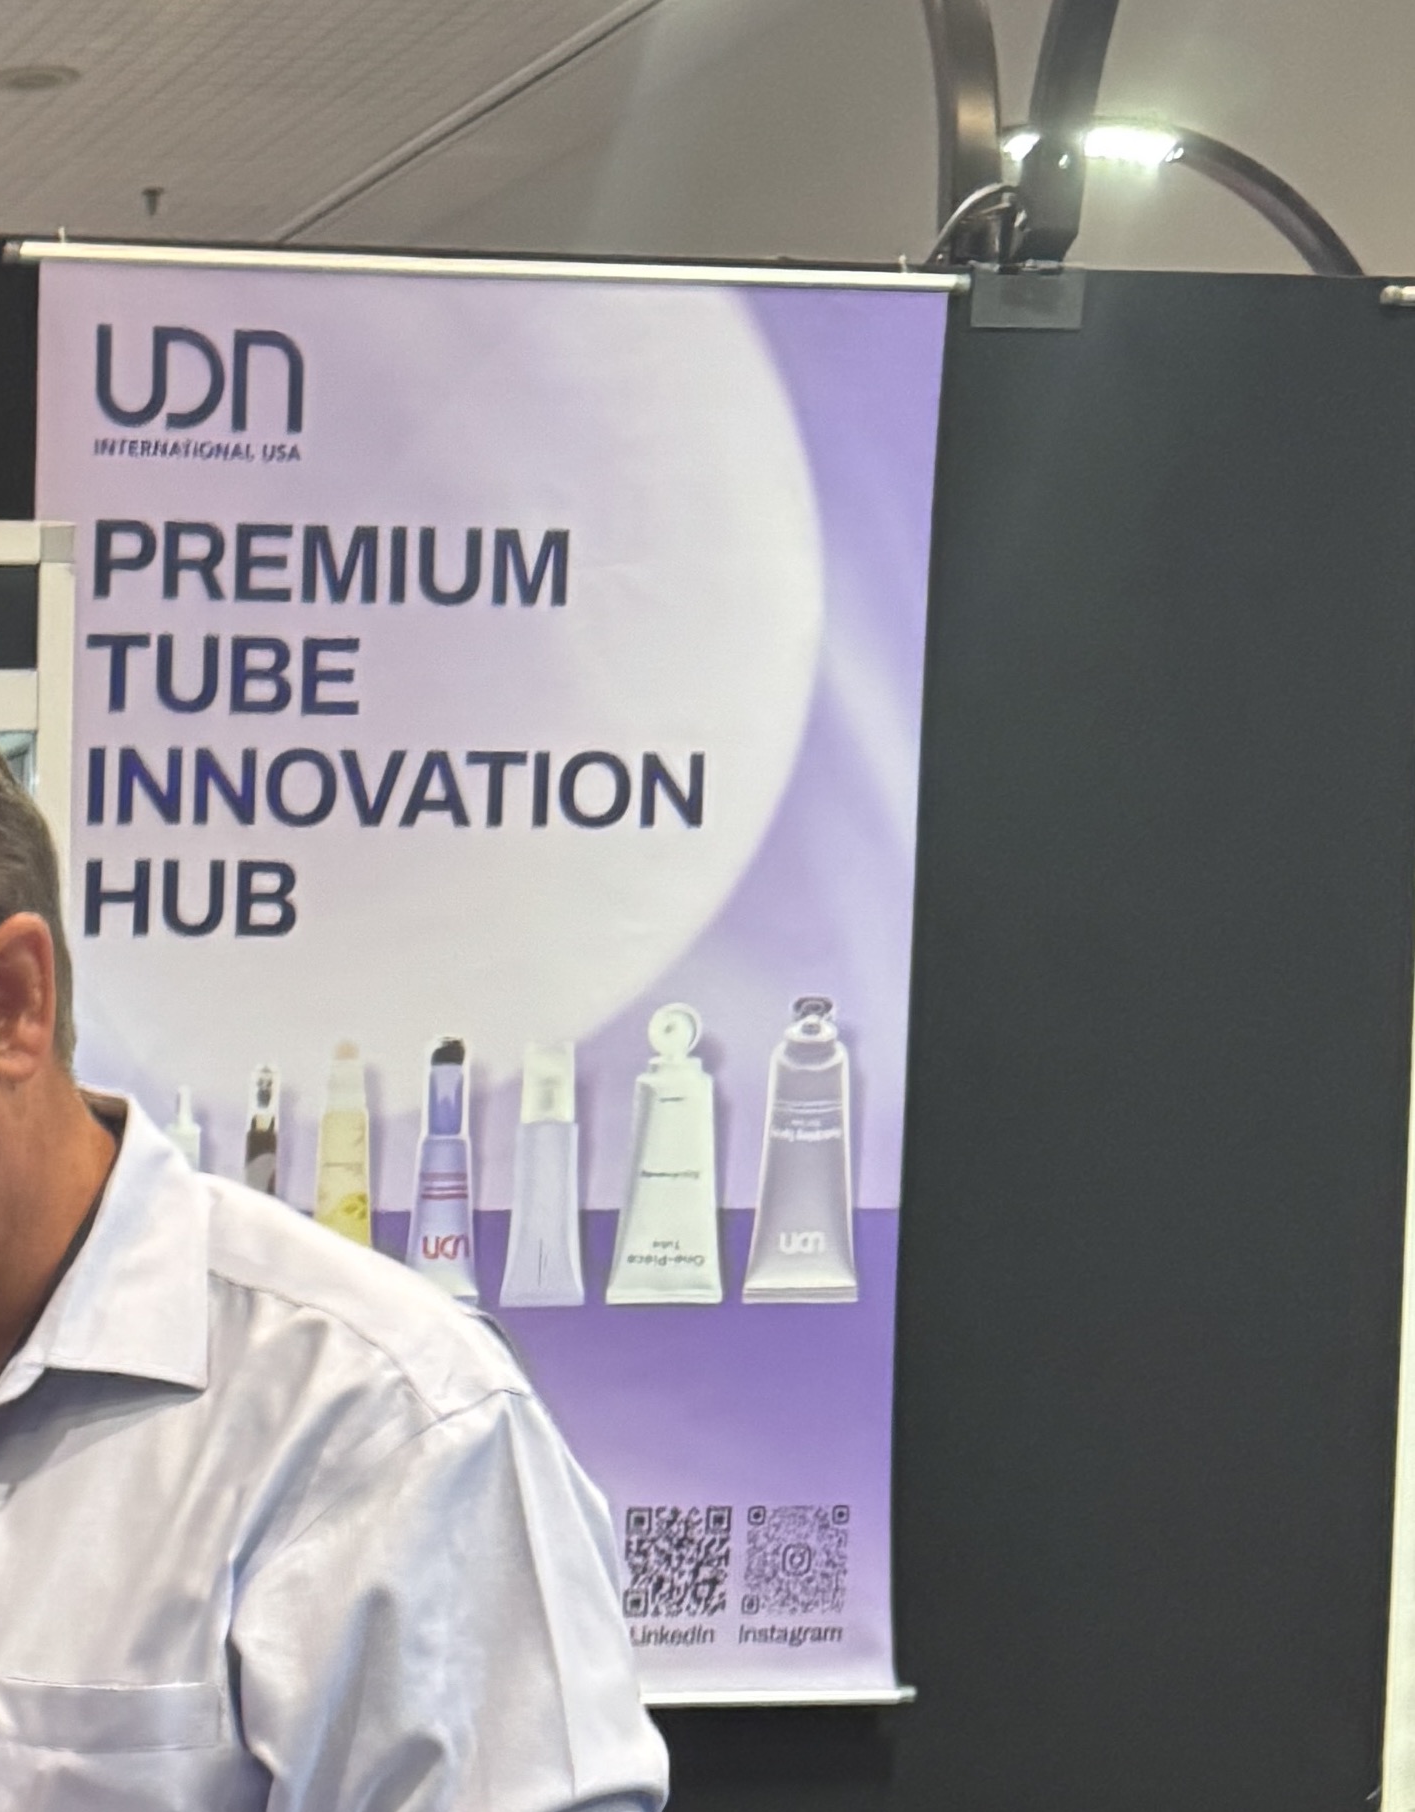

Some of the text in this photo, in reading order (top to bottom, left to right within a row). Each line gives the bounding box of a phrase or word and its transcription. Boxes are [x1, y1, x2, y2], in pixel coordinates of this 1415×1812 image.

[93, 438, 301, 463] INTERNATIONAL USA
[92, 519, 571, 608] PREMIUM
[86, 633, 361, 716] TUBE
[86, 746, 706, 830] INNOVATION
[84, 858, 298, 938] HUB
[737, 1623, 845, 1648] Instagram
